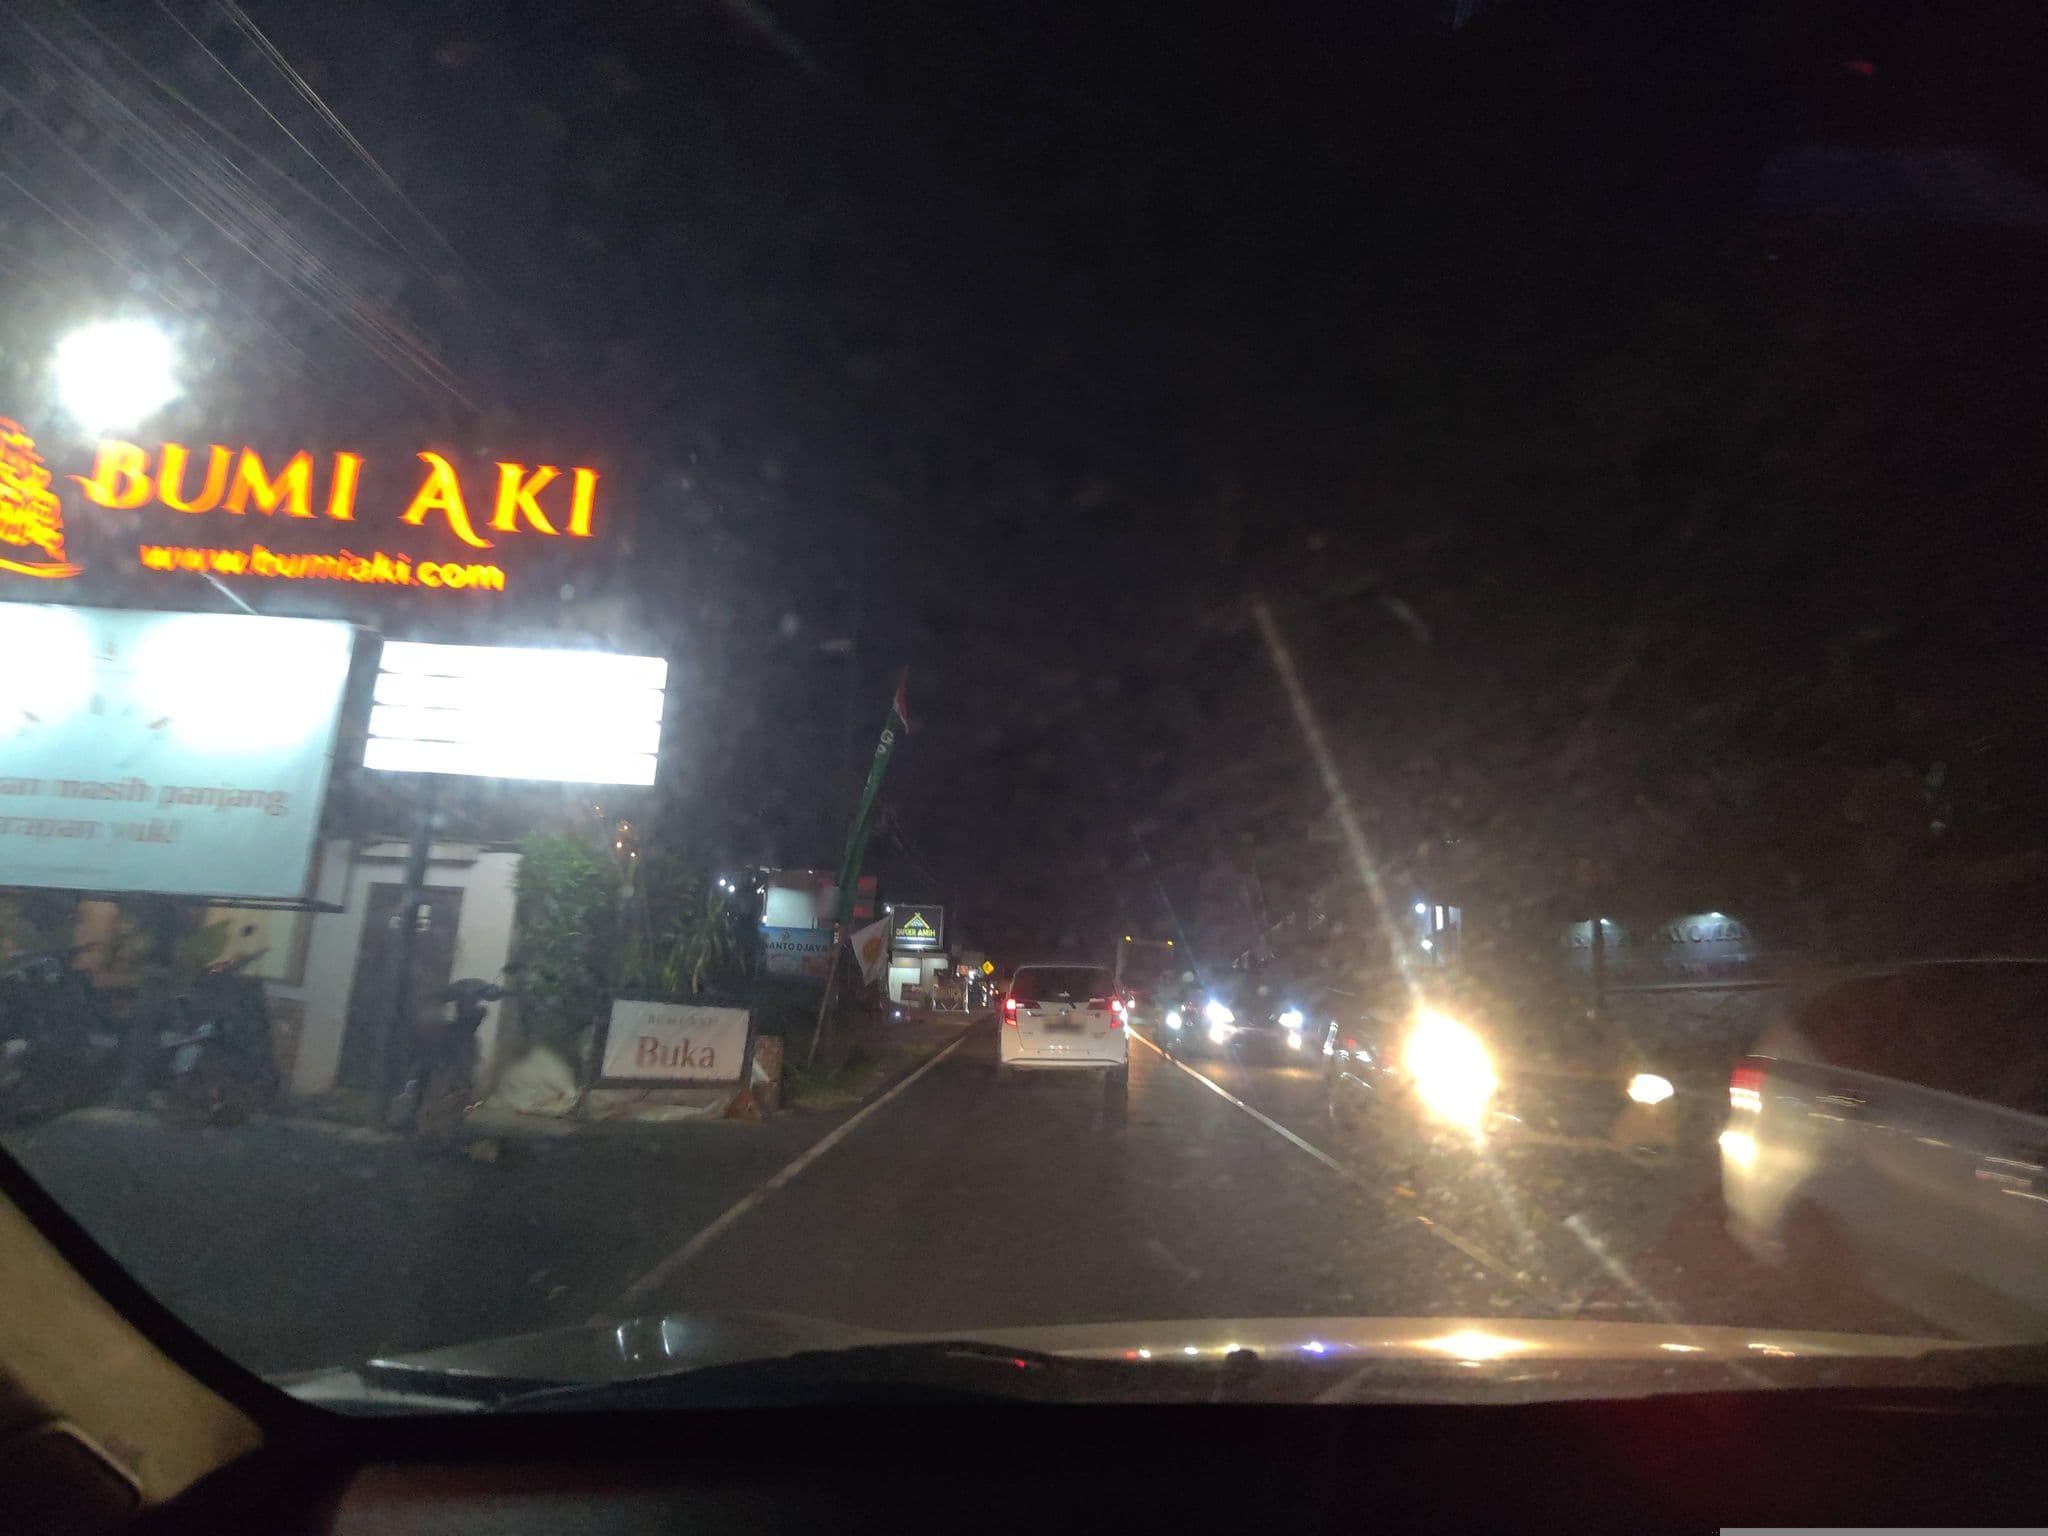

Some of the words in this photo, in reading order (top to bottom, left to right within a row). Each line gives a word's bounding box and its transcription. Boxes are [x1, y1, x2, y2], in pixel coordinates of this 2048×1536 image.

[67, 439, 366, 521] BUMI
[399, 450, 601, 550] AKI
[139, 542, 506, 592] www.bumiaki.com
[157, 782, 290, 817] panjang
[636, 1034, 715, 1068] Buka
